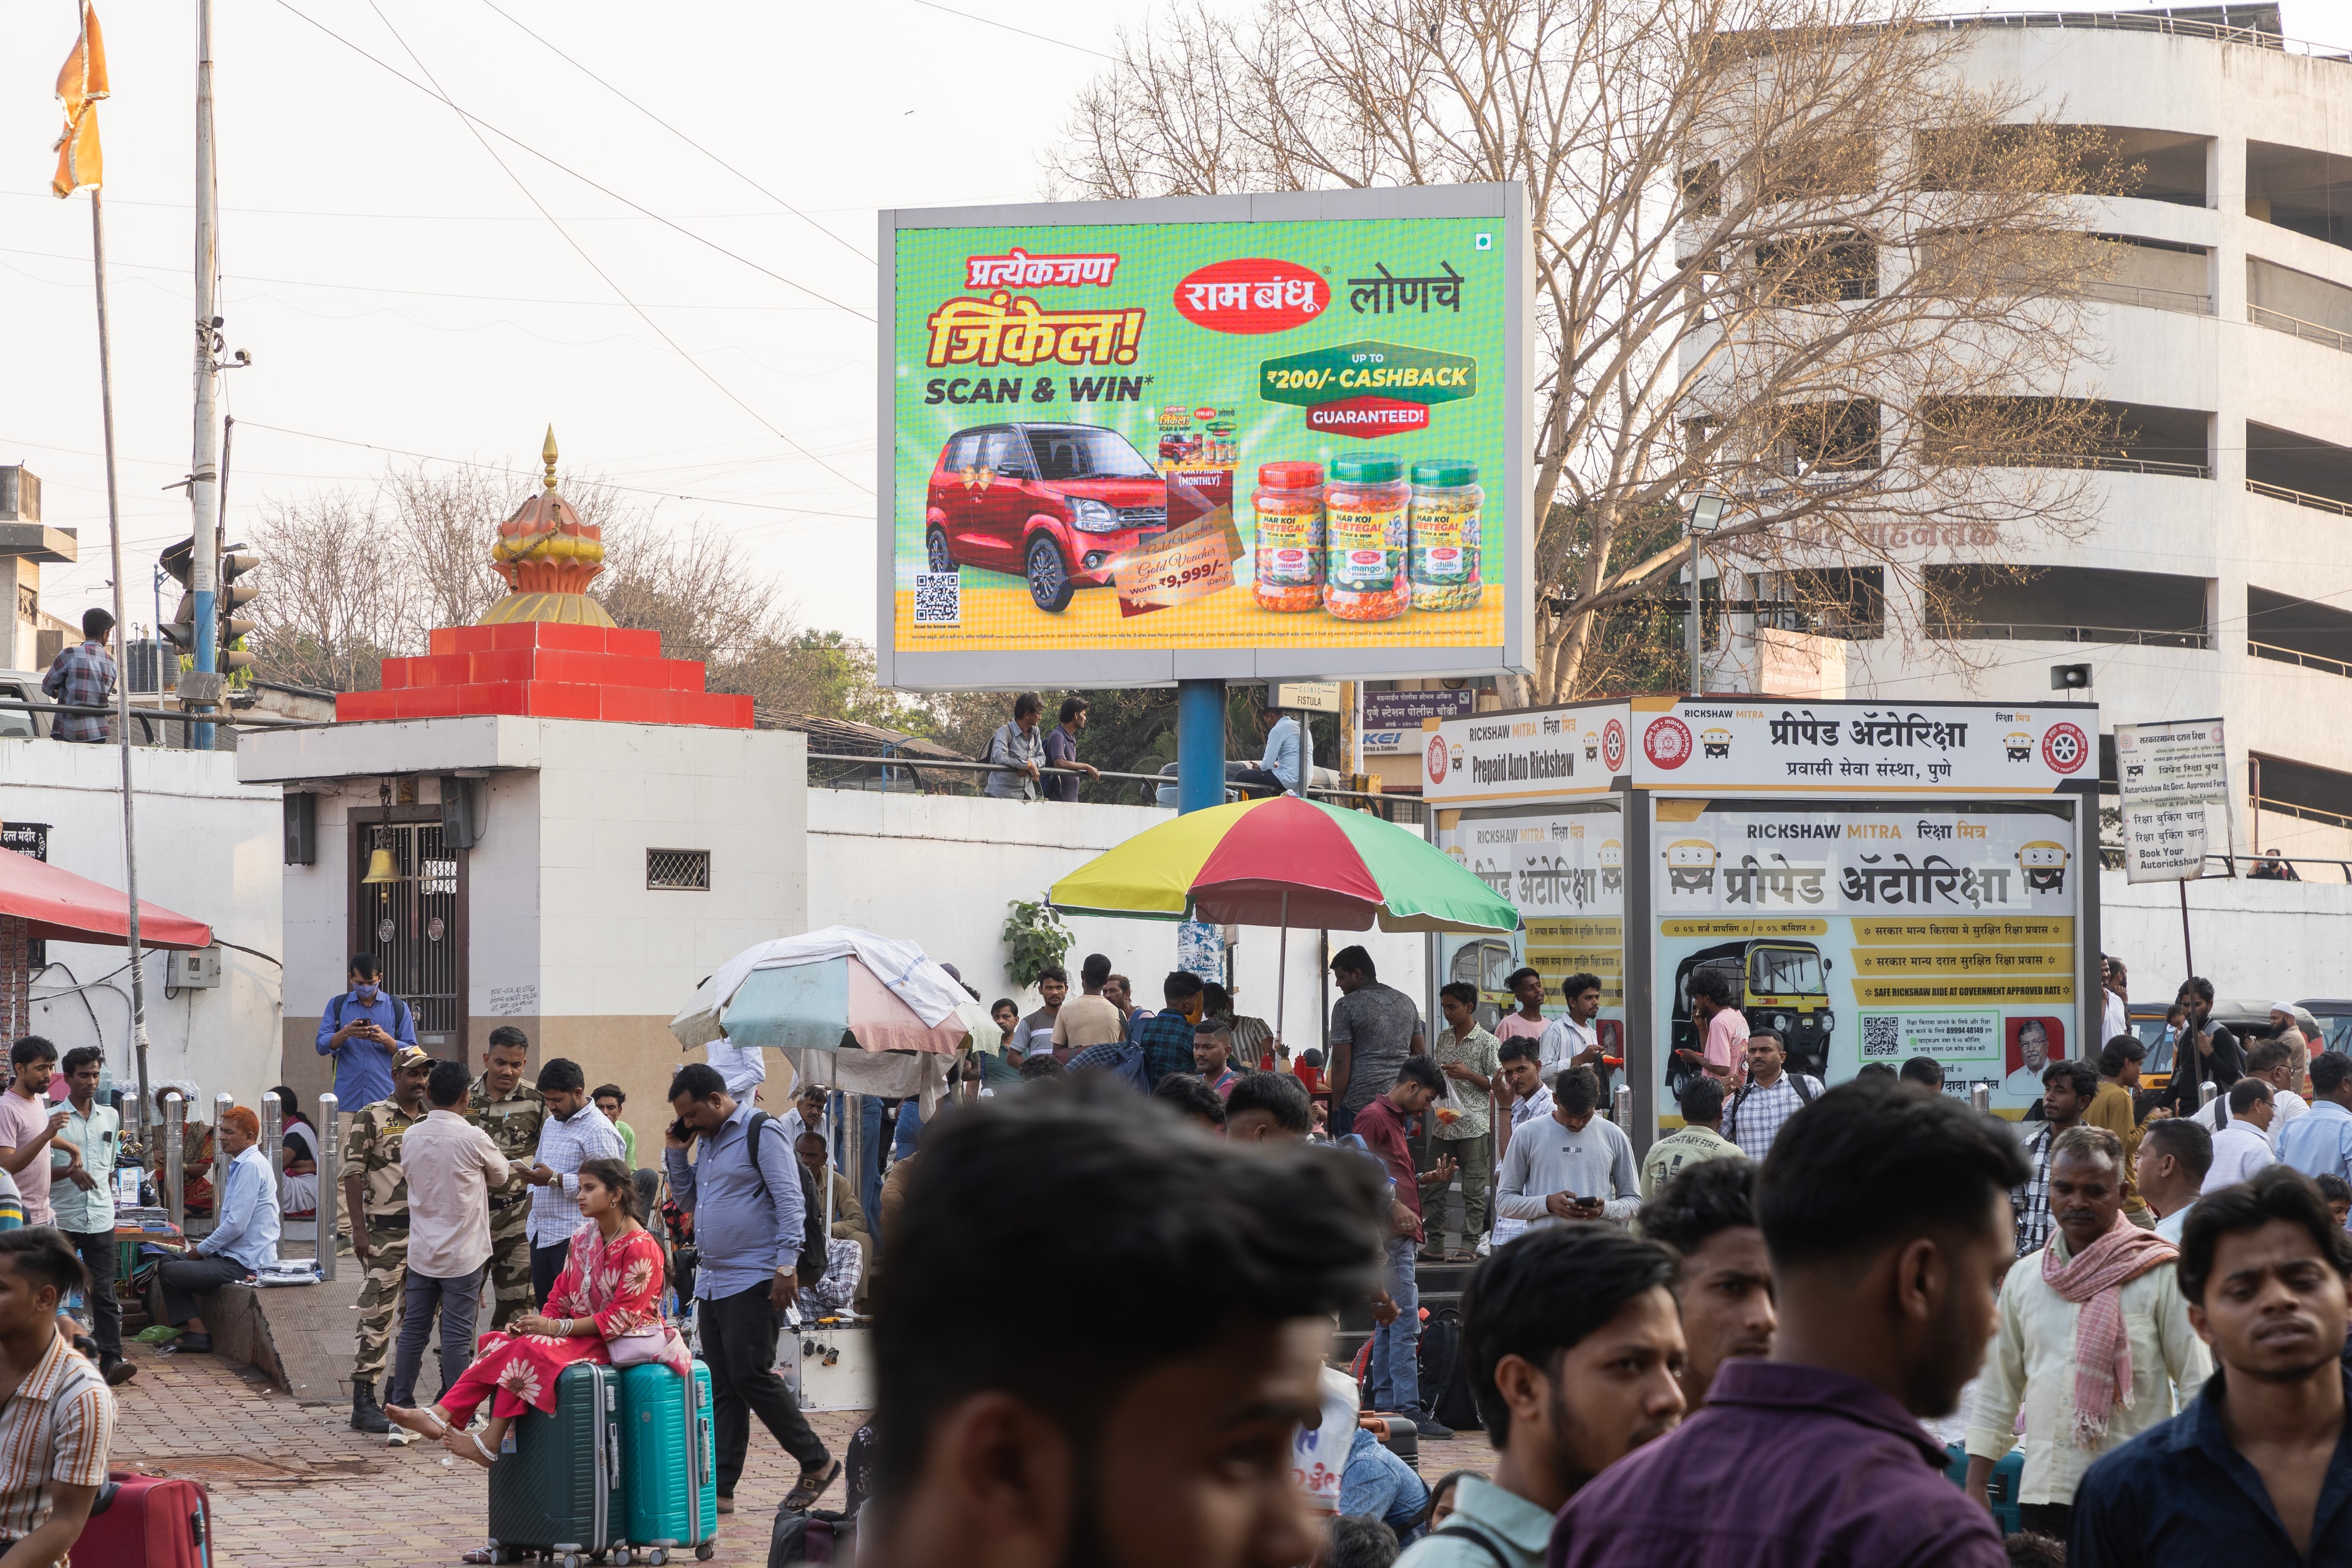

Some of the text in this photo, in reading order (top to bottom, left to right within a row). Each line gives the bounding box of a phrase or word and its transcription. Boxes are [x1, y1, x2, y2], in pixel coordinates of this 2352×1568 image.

[968, 249, 1118, 287] प्रत्येकजण
[1348, 261, 1464, 314] लोणचे
[929, 292, 1144, 366] जिंकेल!
[1351, 353, 1384, 363] UP TO
[1339, 367, 1468, 389] CASHBACK
[924, 377, 1022, 405] SCAN
[1031, 377, 1056, 403] &
[1312, 410, 1424, 424] GUARANTEED!
[1262, 522, 1305, 533] JEETEGA!
[1334, 521, 1382, 532] JEETEGA!
[1415, 521, 1459, 532] JEETEGA!
[1137, 546, 1216, 583] Gold Voucher
[1129, 559, 1224, 595] Worth ₹9,999/-
[1297, 696, 1321, 706] FISTULA
[1366, 703, 1458, 721] पुणे स्टेशन पोलीस चौकी
[1684, 709, 1765, 719] RICKSHAW MITRA
[1995, 712, 2031, 723] रिक्षा मित्र
[1469, 722, 1537, 742] RICKSHAW MITRA
[1544, 714, 1577, 736] रिक्षा मित्र
[1770, 712, 1841, 747] प्रीपेड
[1363, 733, 1402, 745] KEI
[1664, 719, 1690, 758] INDIAN RAILWAYS
[2192, 730, 2206, 741] रिक्षा
[1472, 753, 1507, 786] Prepaid
[1508, 754, 1528, 782] Auto
[1530, 749, 1574, 780] Rickshaw
[2050, 762, 2060, 771] CITY
[2076, 750, 2086, 767] POLICE
[2184, 764, 2202, 772] रिक्षा
[1786, 756, 1952, 783] प्रवासी सेवा संस्था, पुणे
[2124, 784, 2162, 794] Autorickshaw
[2163, 783, 2170, 791] At
[2187, 780, 2212, 791] Approved
[2133, 813, 2153, 825] रिक्षा
[2156, 811, 2182, 826] बुकिंग
[1477, 827, 1545, 845] RICKSHAW MITRA
[1552, 821, 1585, 842] रिक्षा मित्र
[1747, 824, 1902, 839] RICKSHAW MITRA
[1917, 820, 1987, 841] रिक्षा मित्र
[2135, 832, 2154, 843] रिक्षा
[2157, 829, 2184, 844] बुकिंग
[2139, 848, 2184, 858] Book Your
[2140, 857, 2199, 870] Autorickshaw
[1723, 853, 1826, 906] प्रीपेड
[1534, 927, 1548, 936] सरकार
[1781, 922, 1806, 932] कमिशन
[1875, 922, 2048, 938] सरकार मान्य किराया मे सुरक्षित रिक्षा प्रवास
[1876, 953, 2043, 969] सरकार मान्य दरात सुरक्षित रिक्षा प्रवास
[1874, 986, 2061, 997] SAFE RICKSHAW RIDE AT GOVERNMENT APPROVED RATE
[1945, 1080, 1967, 1093] दादा
[1686, 1136, 1701, 1145] MY
[1700, 1139, 1720, 1150] FIRE
